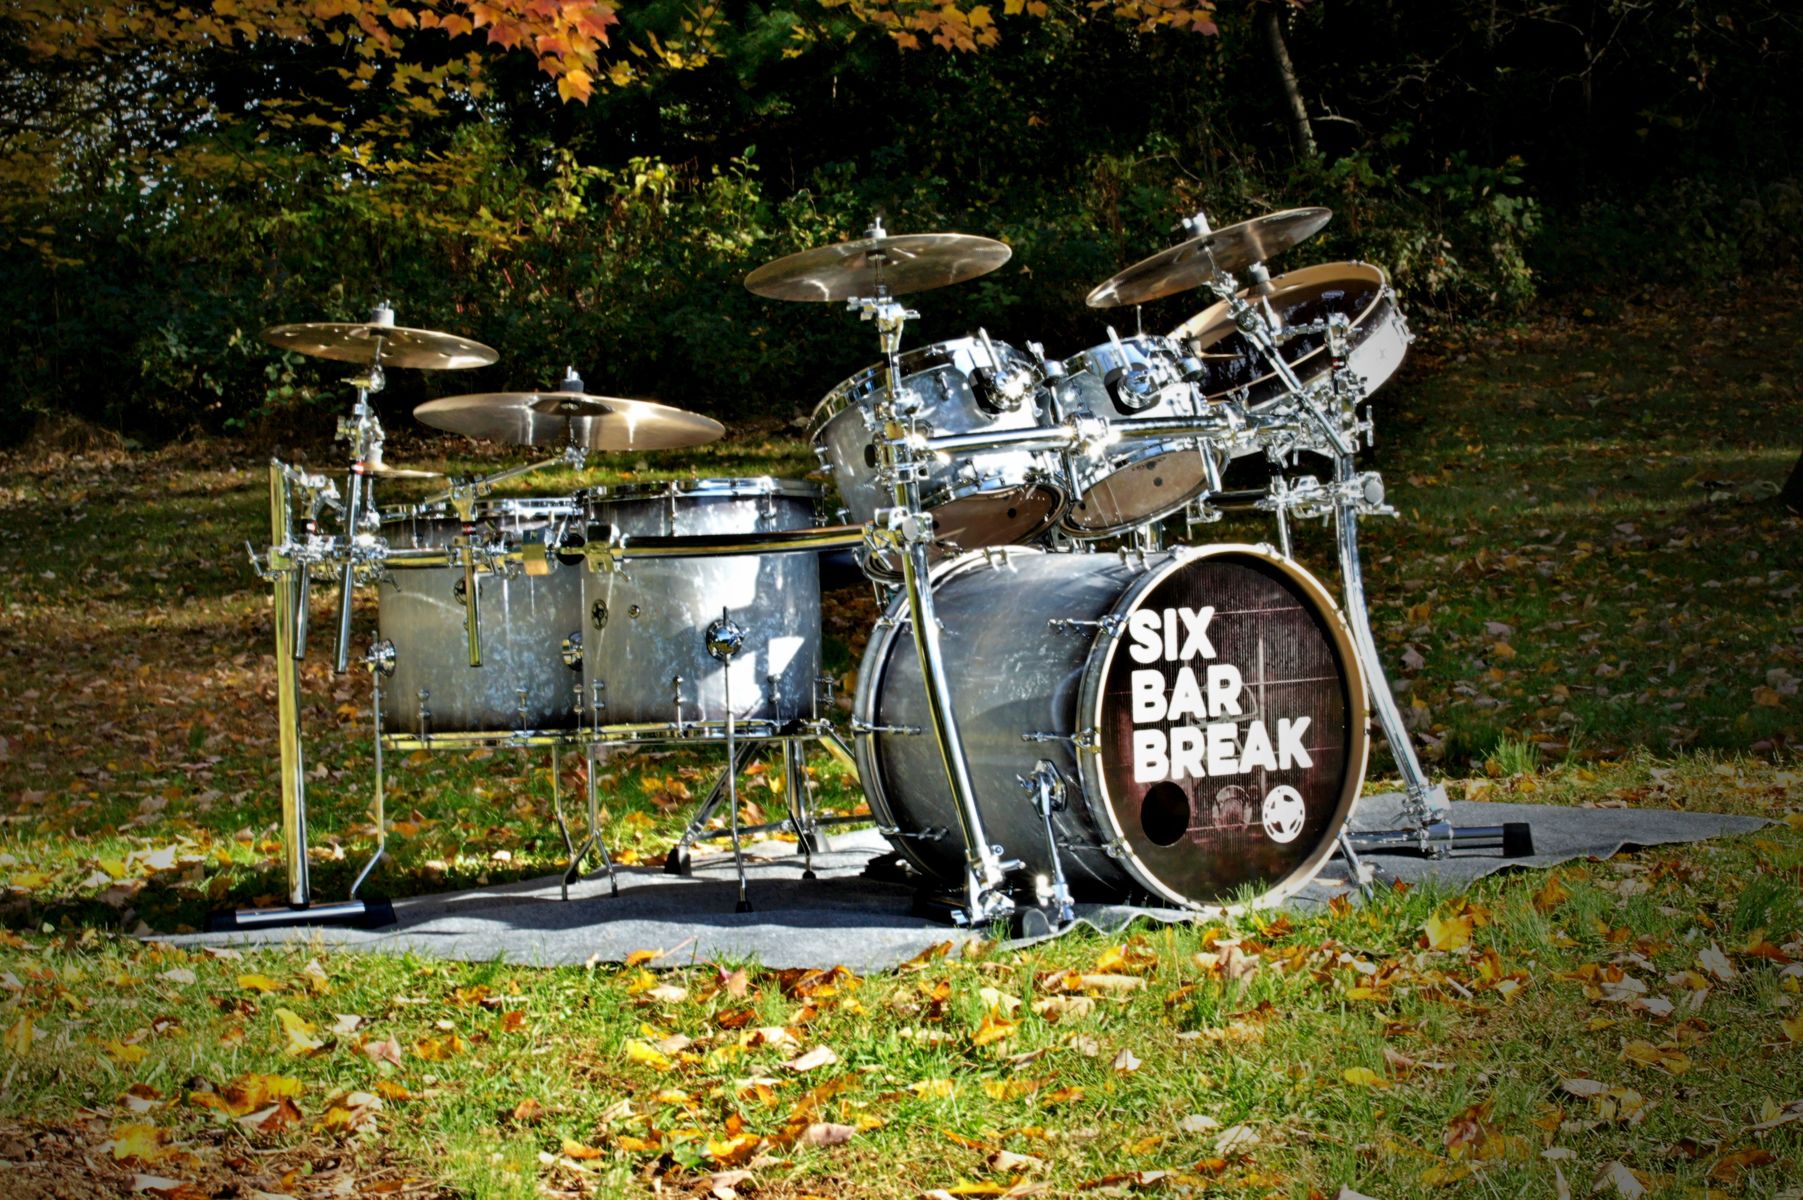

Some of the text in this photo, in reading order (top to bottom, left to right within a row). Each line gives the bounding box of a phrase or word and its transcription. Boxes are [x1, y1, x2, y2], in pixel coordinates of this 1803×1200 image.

[1128, 606, 1217, 664] SIX
[1131, 664, 1243, 724] BAR
[1133, 716, 1313, 784] BREAK
